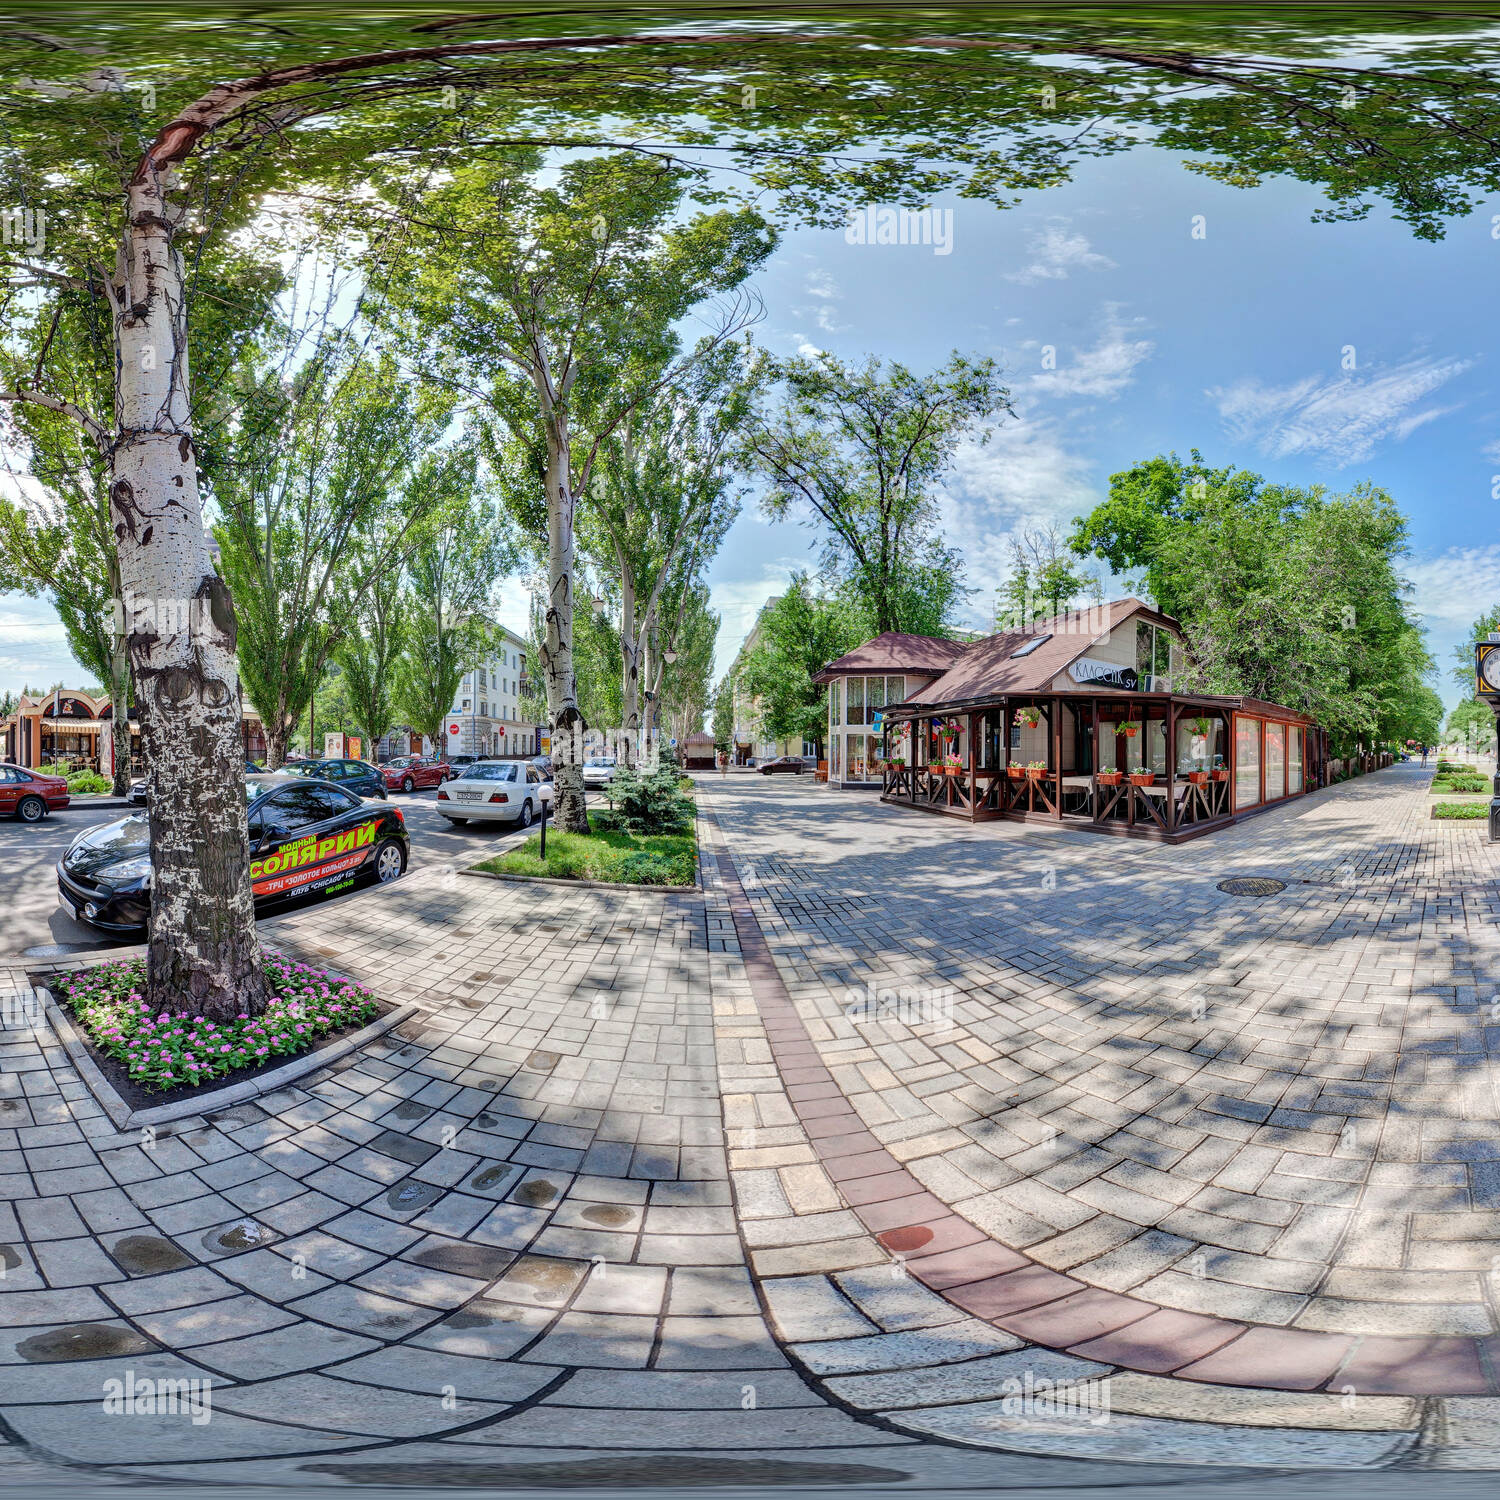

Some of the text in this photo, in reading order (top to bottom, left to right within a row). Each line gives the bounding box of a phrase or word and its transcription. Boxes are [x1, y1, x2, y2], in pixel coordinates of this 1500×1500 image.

[250, 820, 376, 879] СОЛЯРИЙ
[278, 834, 317, 854] МОДНЫЙ
[291, 885, 309, 896] КЛУБ
